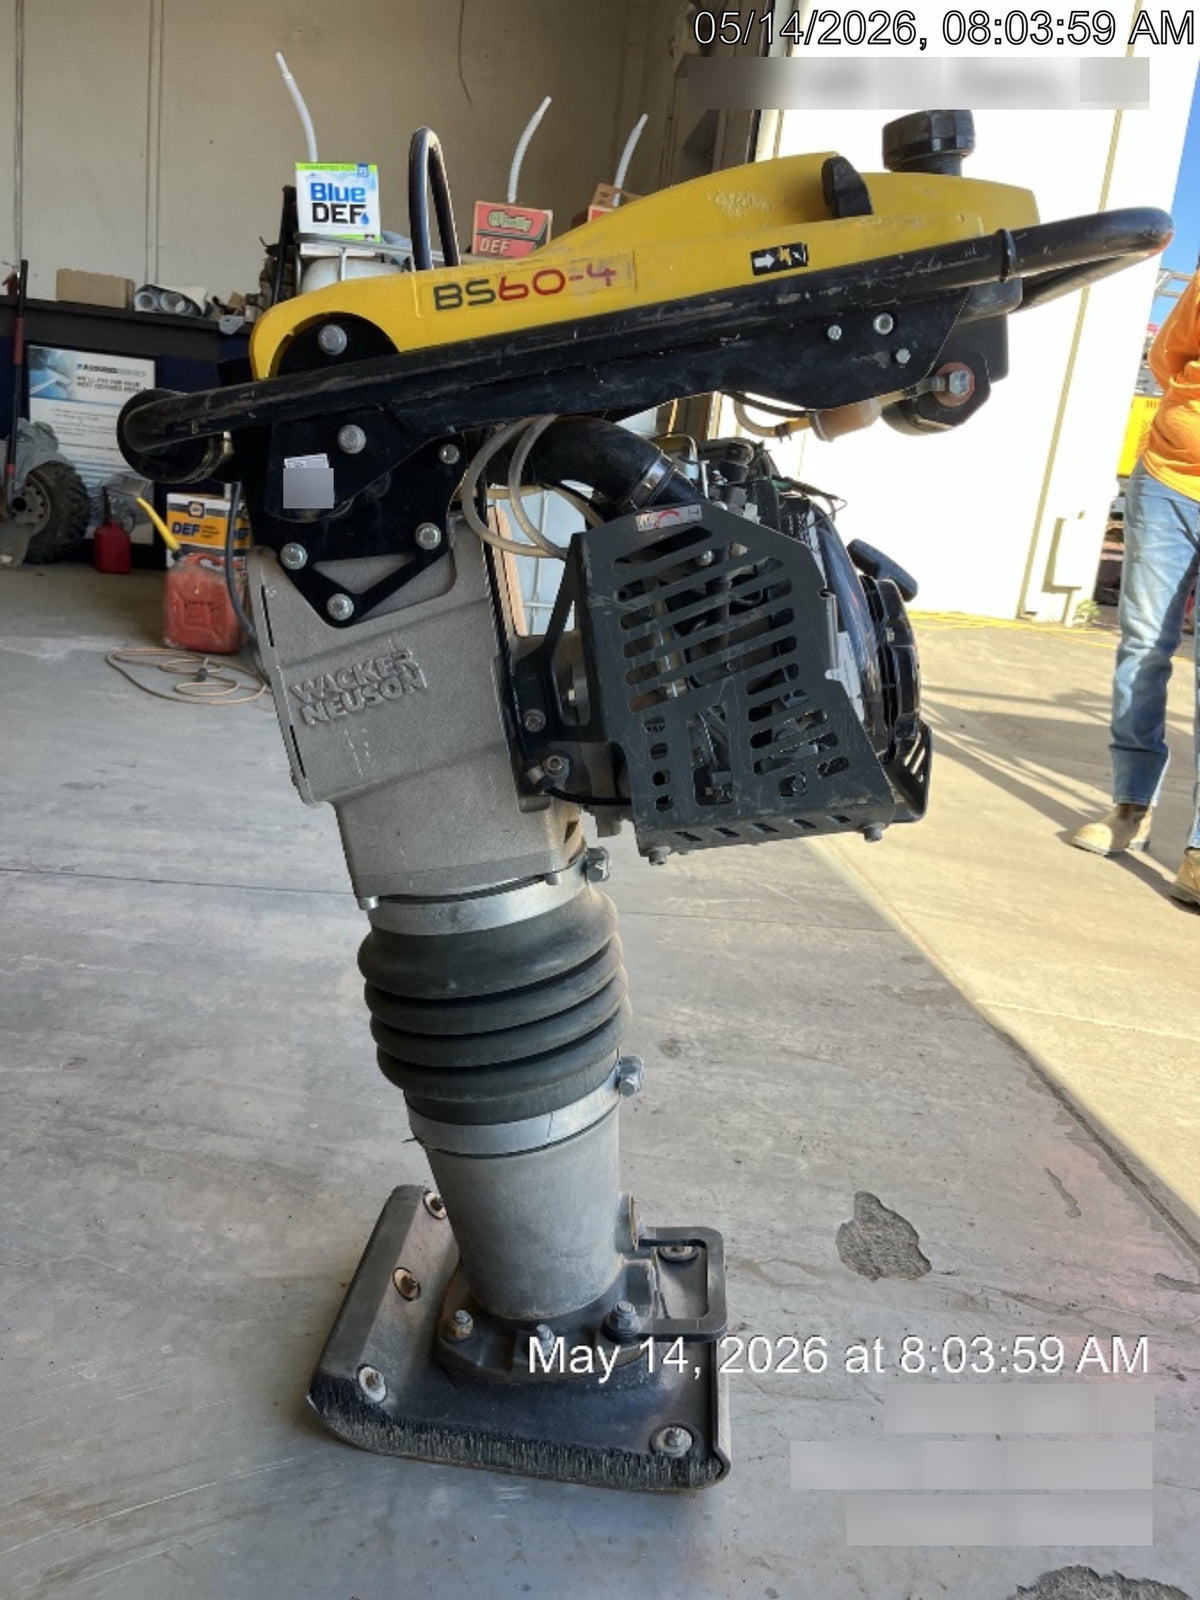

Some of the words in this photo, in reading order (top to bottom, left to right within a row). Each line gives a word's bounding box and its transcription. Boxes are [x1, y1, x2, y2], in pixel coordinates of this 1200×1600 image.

[310, 182, 366, 202] Blue
[312, 203, 366, 224] DEF
[479, 238, 511, 255] DEF
[172, 521, 200, 536] DEF
[290, 650, 417, 704] WACKER
[300, 664, 428, 726] NEUSON
